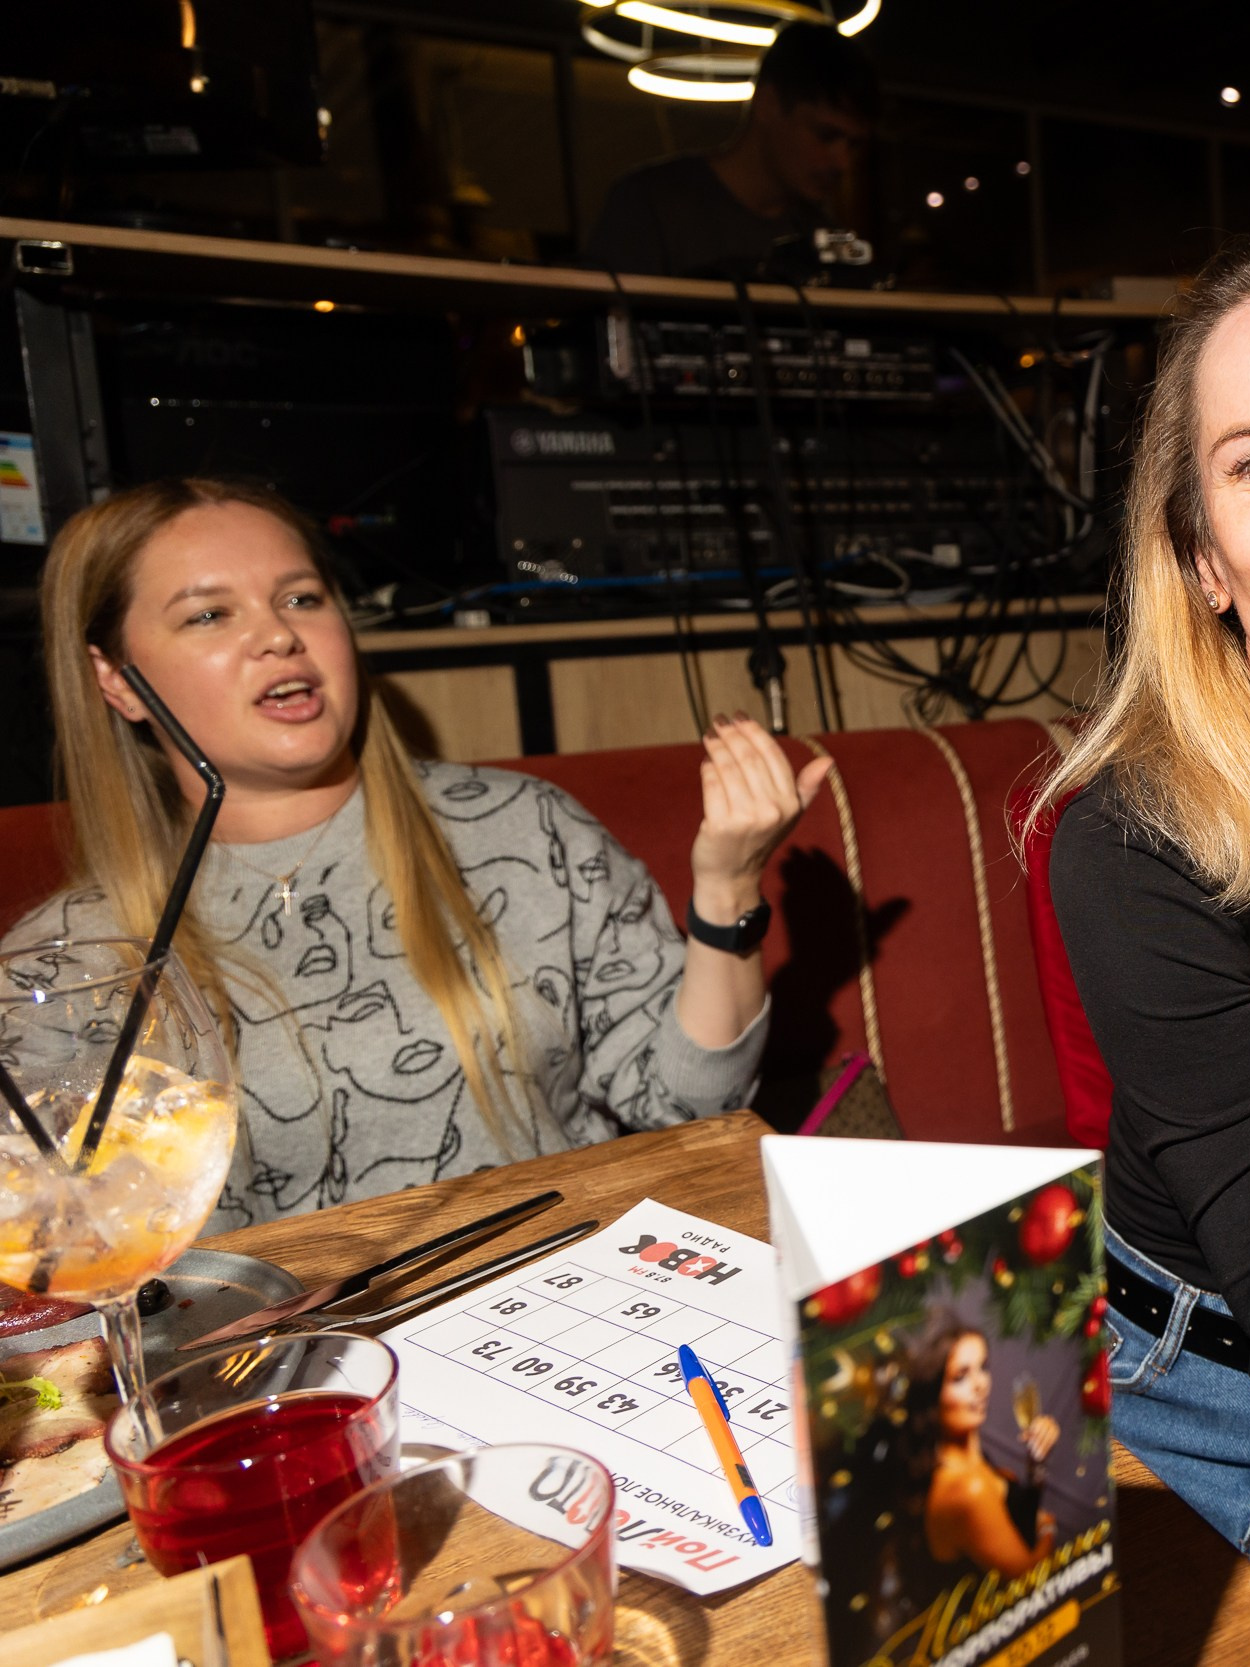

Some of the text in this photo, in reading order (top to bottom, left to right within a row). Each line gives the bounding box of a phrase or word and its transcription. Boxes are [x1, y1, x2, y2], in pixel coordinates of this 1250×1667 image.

[681, 1231, 731, 1253] РАДИО
[627, 1265, 647, 1276] FM
[489, 1297, 528, 1315] 81
[543, 1273, 661, 1320] 65 87
[471, 1340, 640, 1415] 43 59 60 73
[748, 1399, 789, 1420] 21
[634, 1487, 758, 1547] МУЗЫКАЛЬНОЕ
